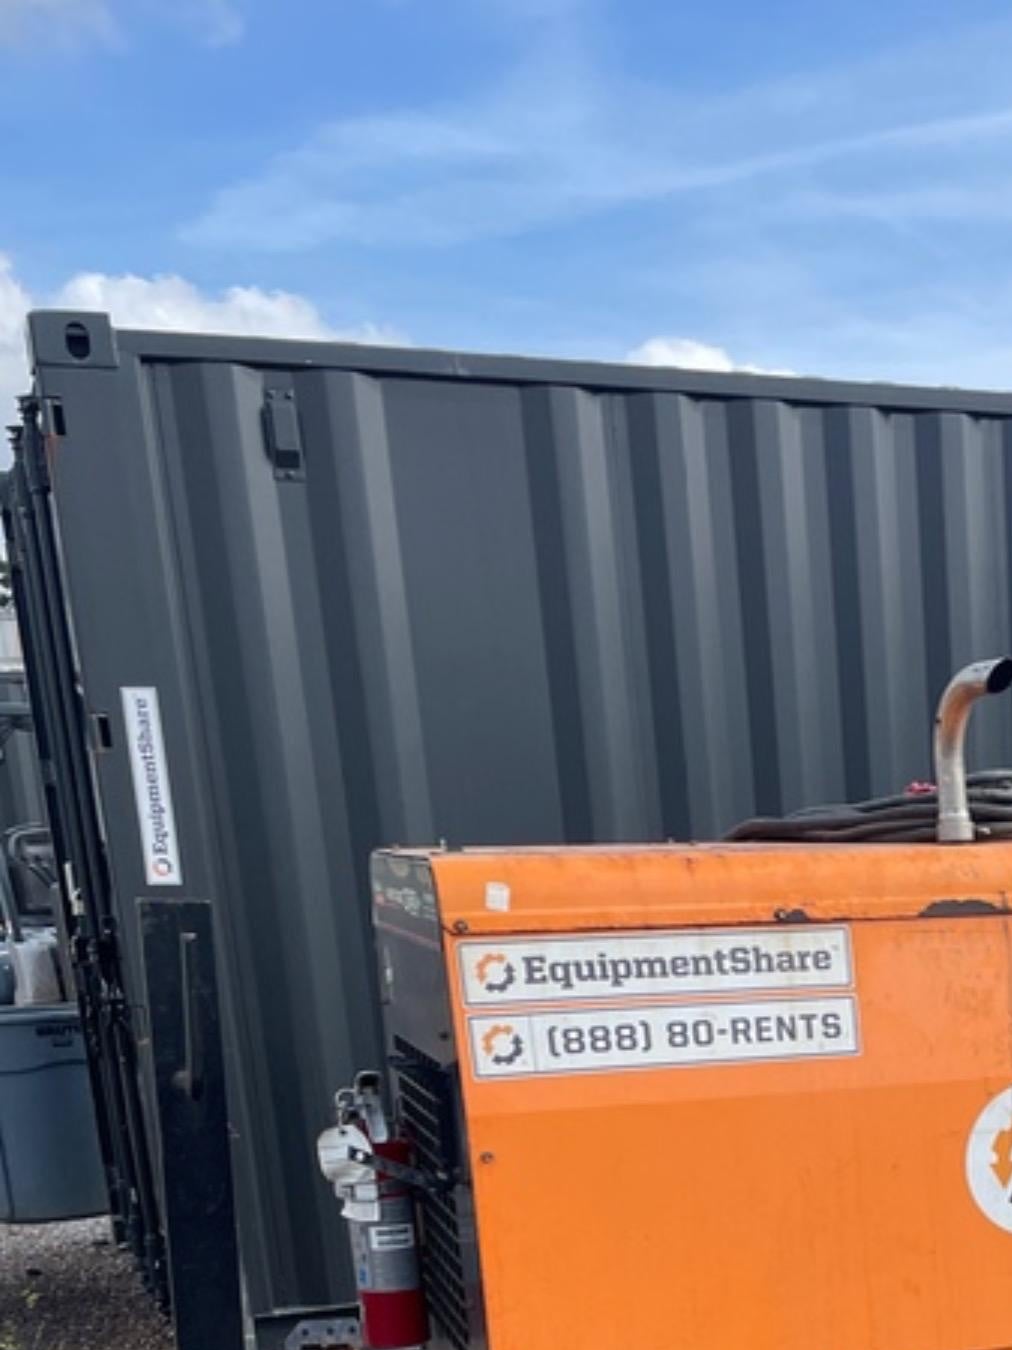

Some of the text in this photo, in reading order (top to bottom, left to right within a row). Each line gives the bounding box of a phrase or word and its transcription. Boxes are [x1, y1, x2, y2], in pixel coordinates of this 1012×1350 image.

[136, 698, 169, 855] EquipmentShare
[522, 947, 832, 988] EquipmentShare
[546, 1012, 842, 1058] (888) 80-RENTS
